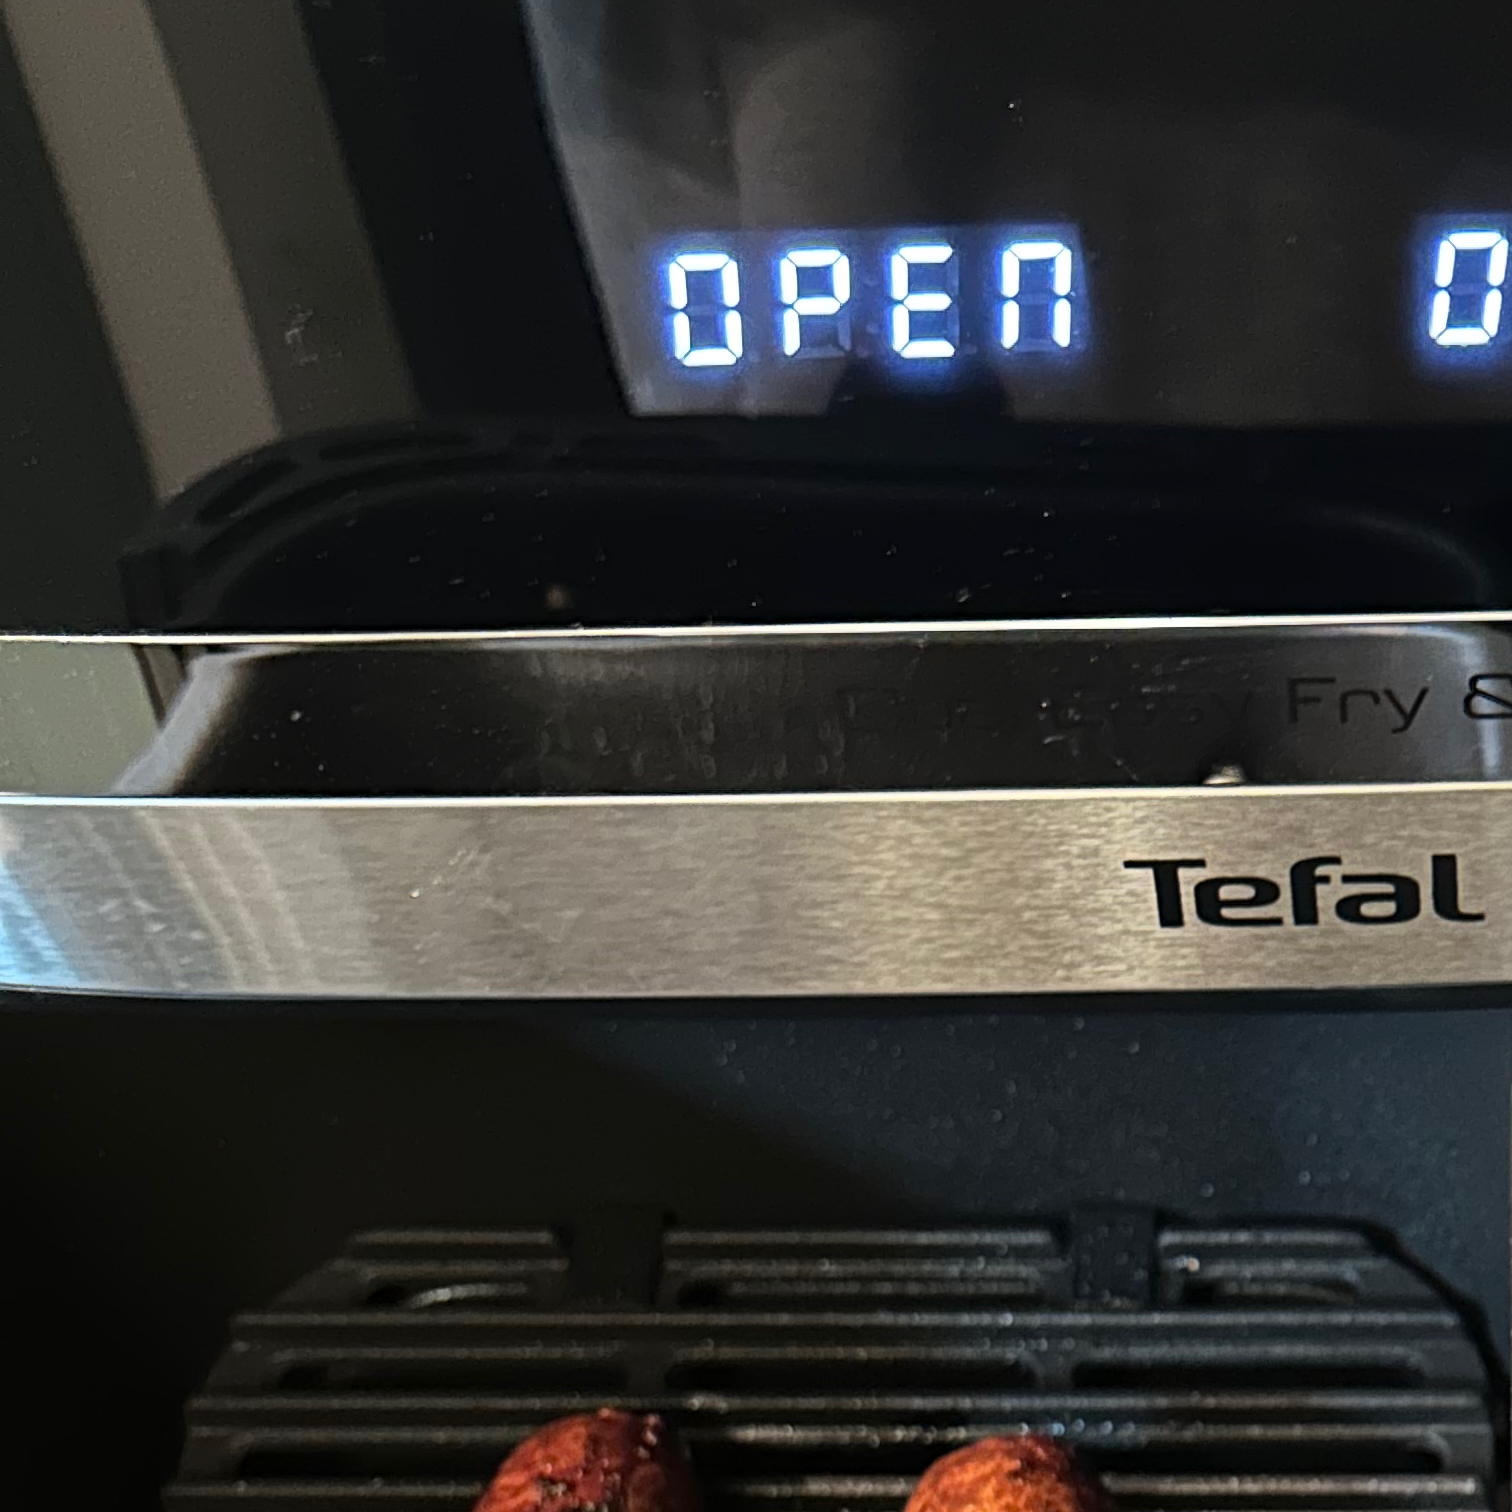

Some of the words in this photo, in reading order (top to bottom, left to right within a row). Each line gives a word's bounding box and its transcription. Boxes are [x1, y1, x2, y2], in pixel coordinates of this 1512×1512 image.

[667, 237, 1074, 368] OPEN
[1287, 675, 1430, 734] Fry
[1122, 853, 1486, 929] Tefal
